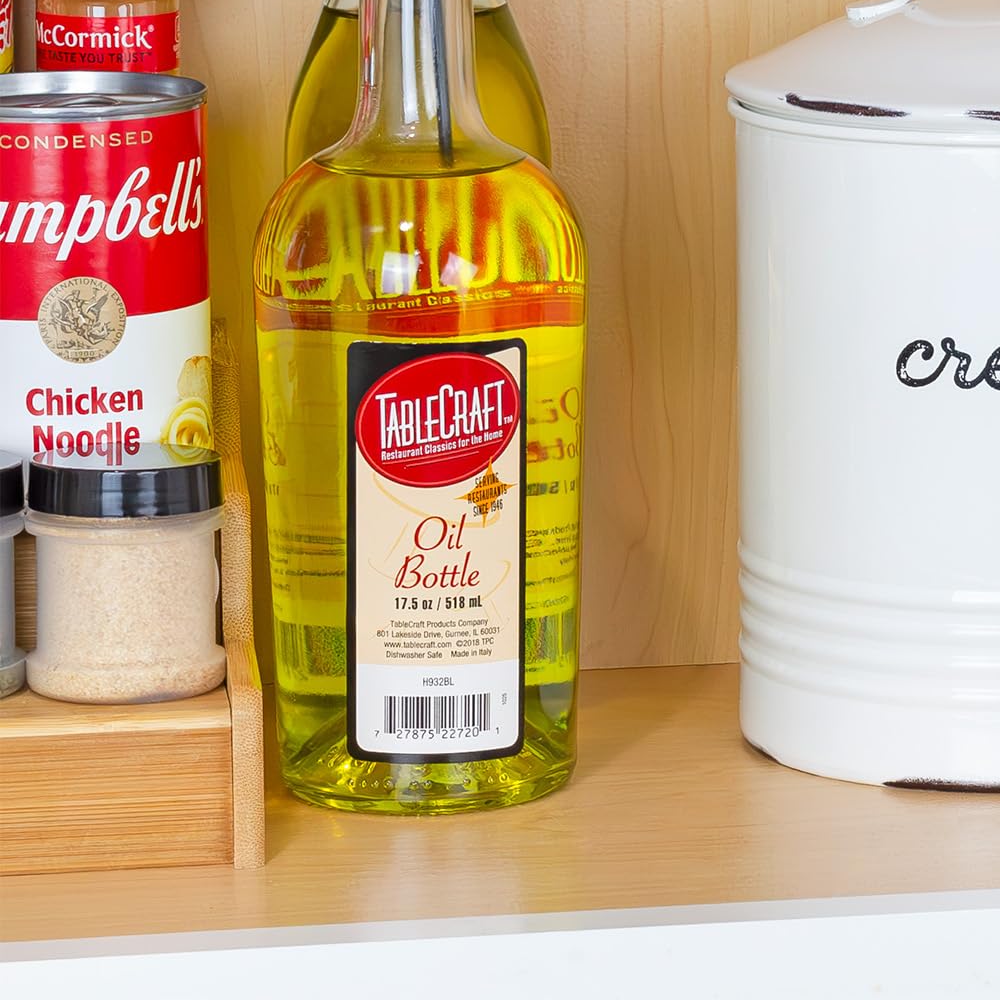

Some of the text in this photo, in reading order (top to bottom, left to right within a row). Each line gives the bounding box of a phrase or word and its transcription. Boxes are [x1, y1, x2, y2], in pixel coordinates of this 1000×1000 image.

[48, 51, 77, 63] TASTE
[79, 52, 105, 64] YOU
[0, 130, 153, 149] CONDENSED
[0, 156, 202, 261] mpbell's
[42, 278, 107, 312] INTERNATIONAL
[111, 292, 124, 346] EXPOSITION
[26, 387, 143, 415] Chicken
[33, 422, 140, 454] Noodle
[381, 430, 503, 461] Restaurant Classics for the Home
[467, 484, 507, 504] RESTAURANTS
[473, 503, 489, 517] SINCE
[414, 513, 467, 551] Oil
[394, 551, 480, 589] Bottle
[395, 598, 418, 610] 17.5
[422, 599, 433, 609] oz
[445, 597, 465, 609] 518
[469, 596, 482, 608] mL
[391, 619, 488, 628] TableCraft Products Company
[424, 631, 443, 639] Drive,
[480, 627, 500, 635] 60031
[384, 640, 452, 649] www.tablecraft.com
[386, 650, 425, 658] Dishwasher
[427, 650, 442, 658] Safe
[479, 647, 492, 656] Italy
[422, 677, 454, 686] H932BL
[396, 729, 435, 739] 27875
[442, 728, 479, 739] 22720
